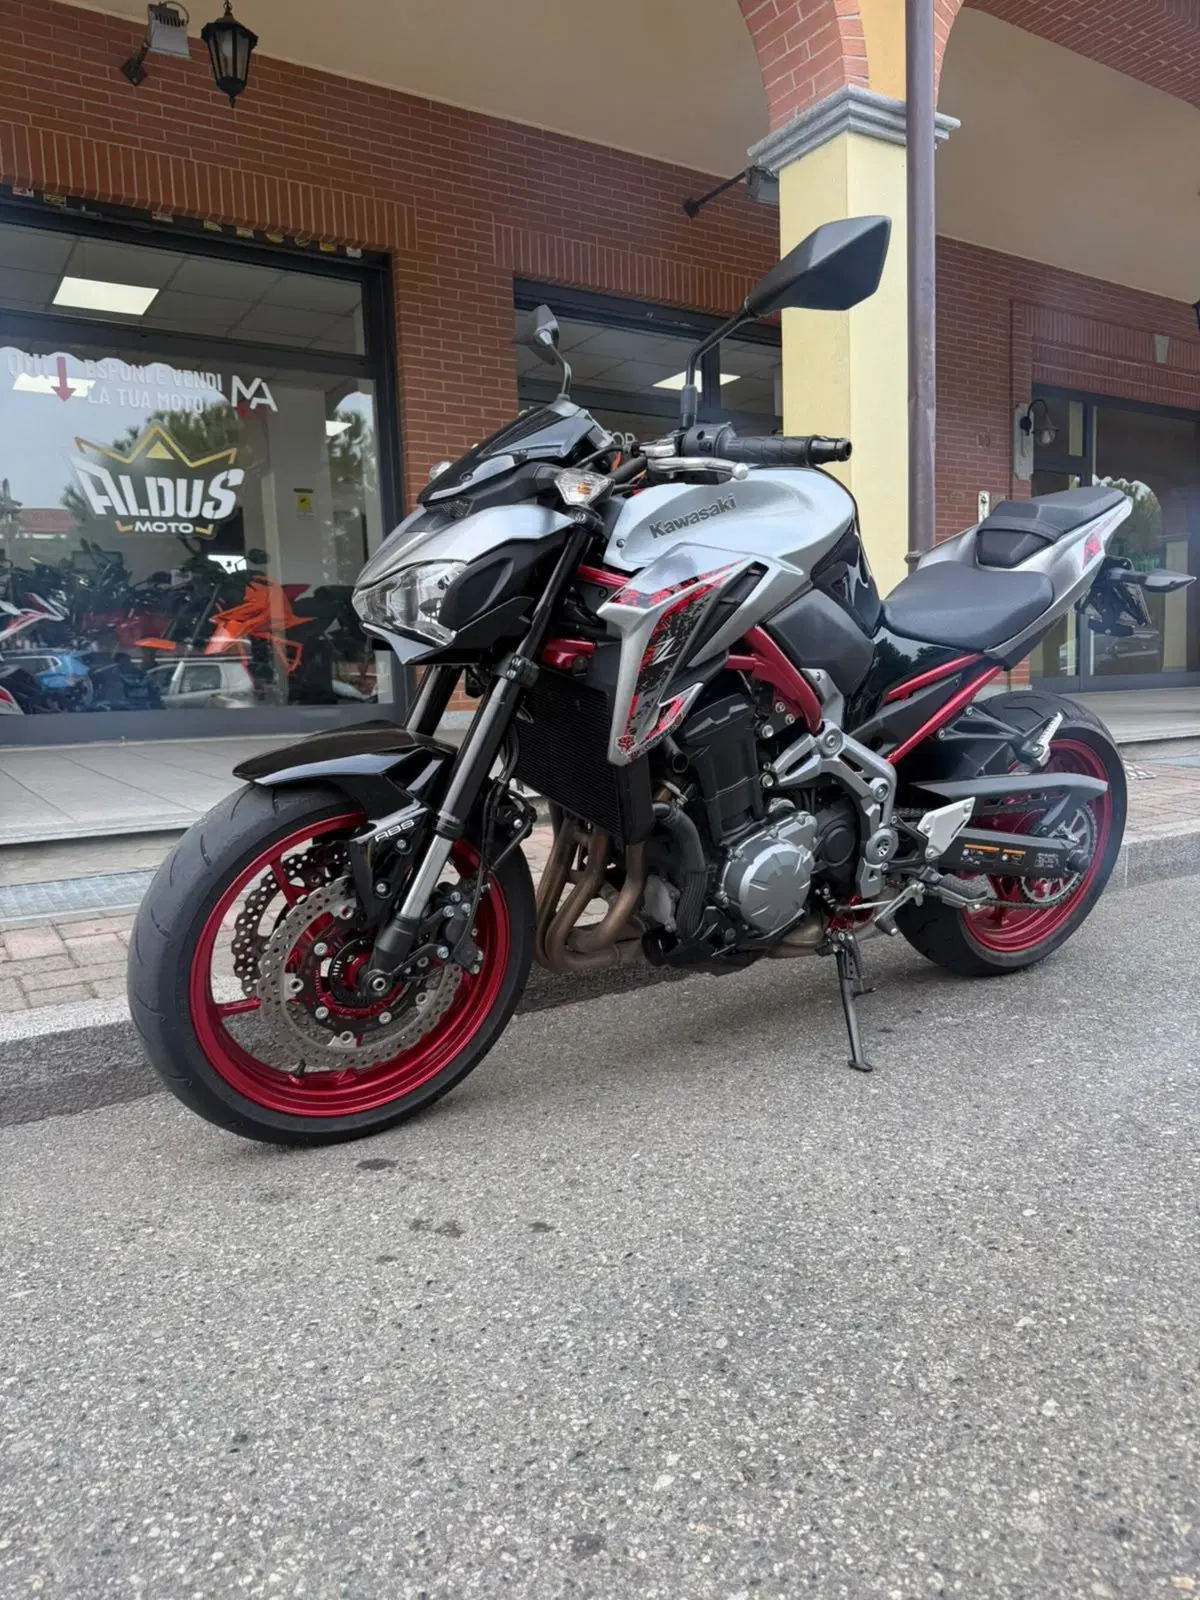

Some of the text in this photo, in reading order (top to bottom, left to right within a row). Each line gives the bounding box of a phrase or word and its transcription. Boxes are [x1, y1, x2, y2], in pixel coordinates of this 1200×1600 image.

[172, 369, 222, 391] VENDI
[87, 386, 204, 415] LA TUA MOTO
[69, 456, 245, 520] ALDUS
[134, 521, 194, 534] MOTO
[649, 494, 737, 539] Kawasaki
[374, 819, 415, 843] ABS
